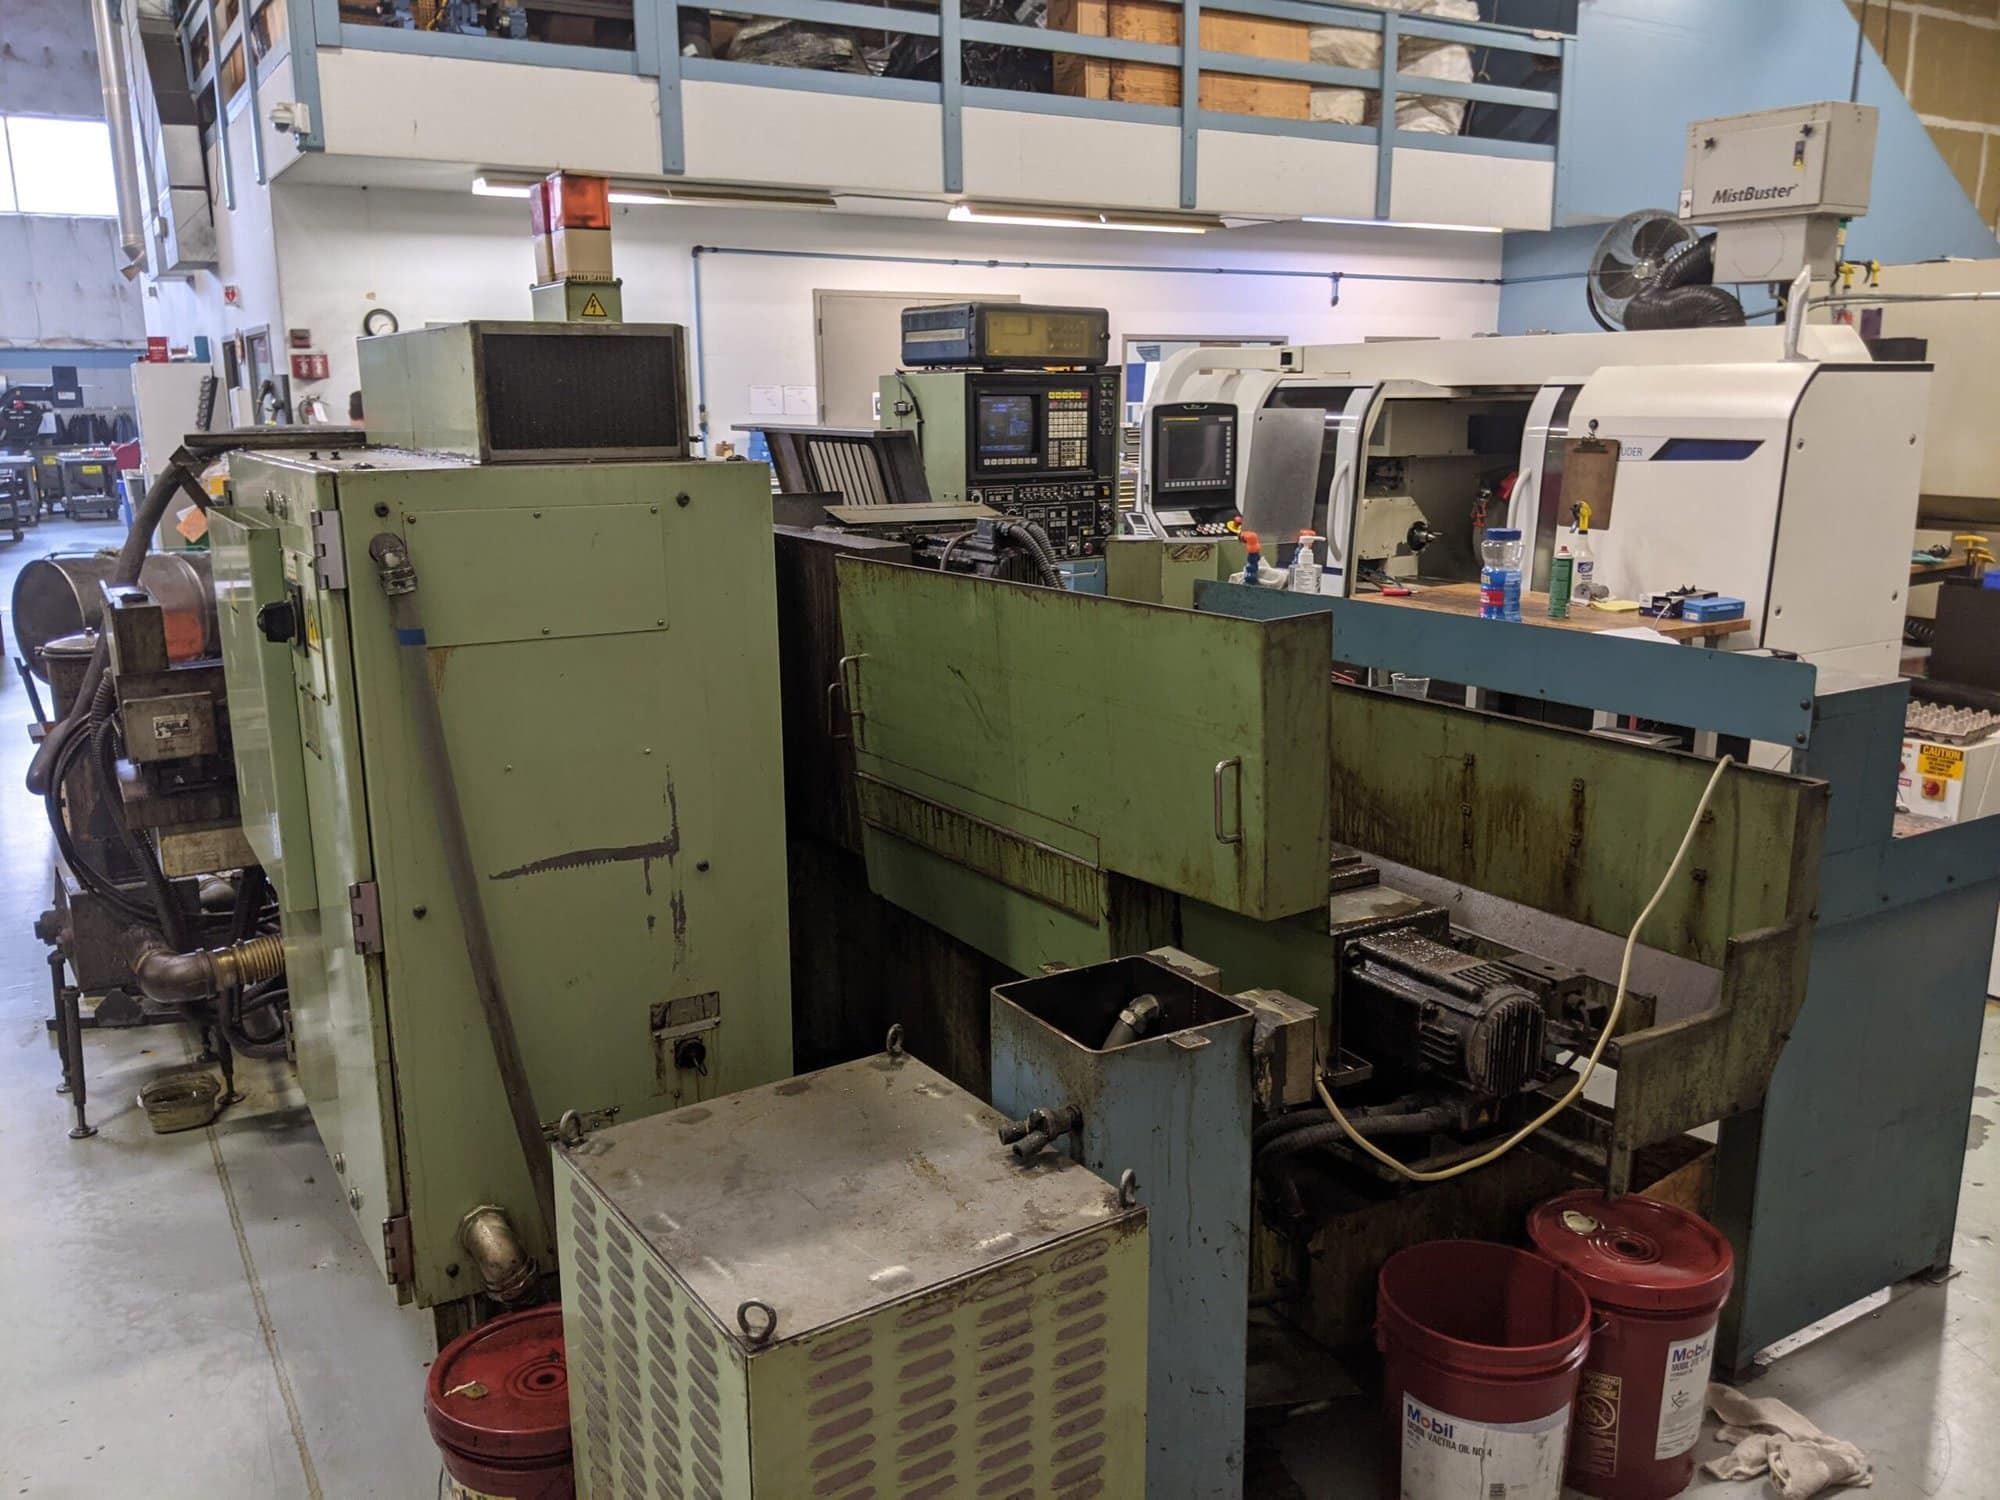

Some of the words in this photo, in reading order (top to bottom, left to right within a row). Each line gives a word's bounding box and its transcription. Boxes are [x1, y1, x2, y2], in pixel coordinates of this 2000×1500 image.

[1712, 185, 1796, 204] MistBuster
[1620, 447, 1643, 456] UDER
[1922, 744, 1961, 761] CAUTION
[1672, 1340, 1707, 1362] Mobil
[1407, 1403, 1454, 1439] Mobil
[1458, 1443, 1471, 1455] OIL
[1486, 1448, 1493, 1457] 4
